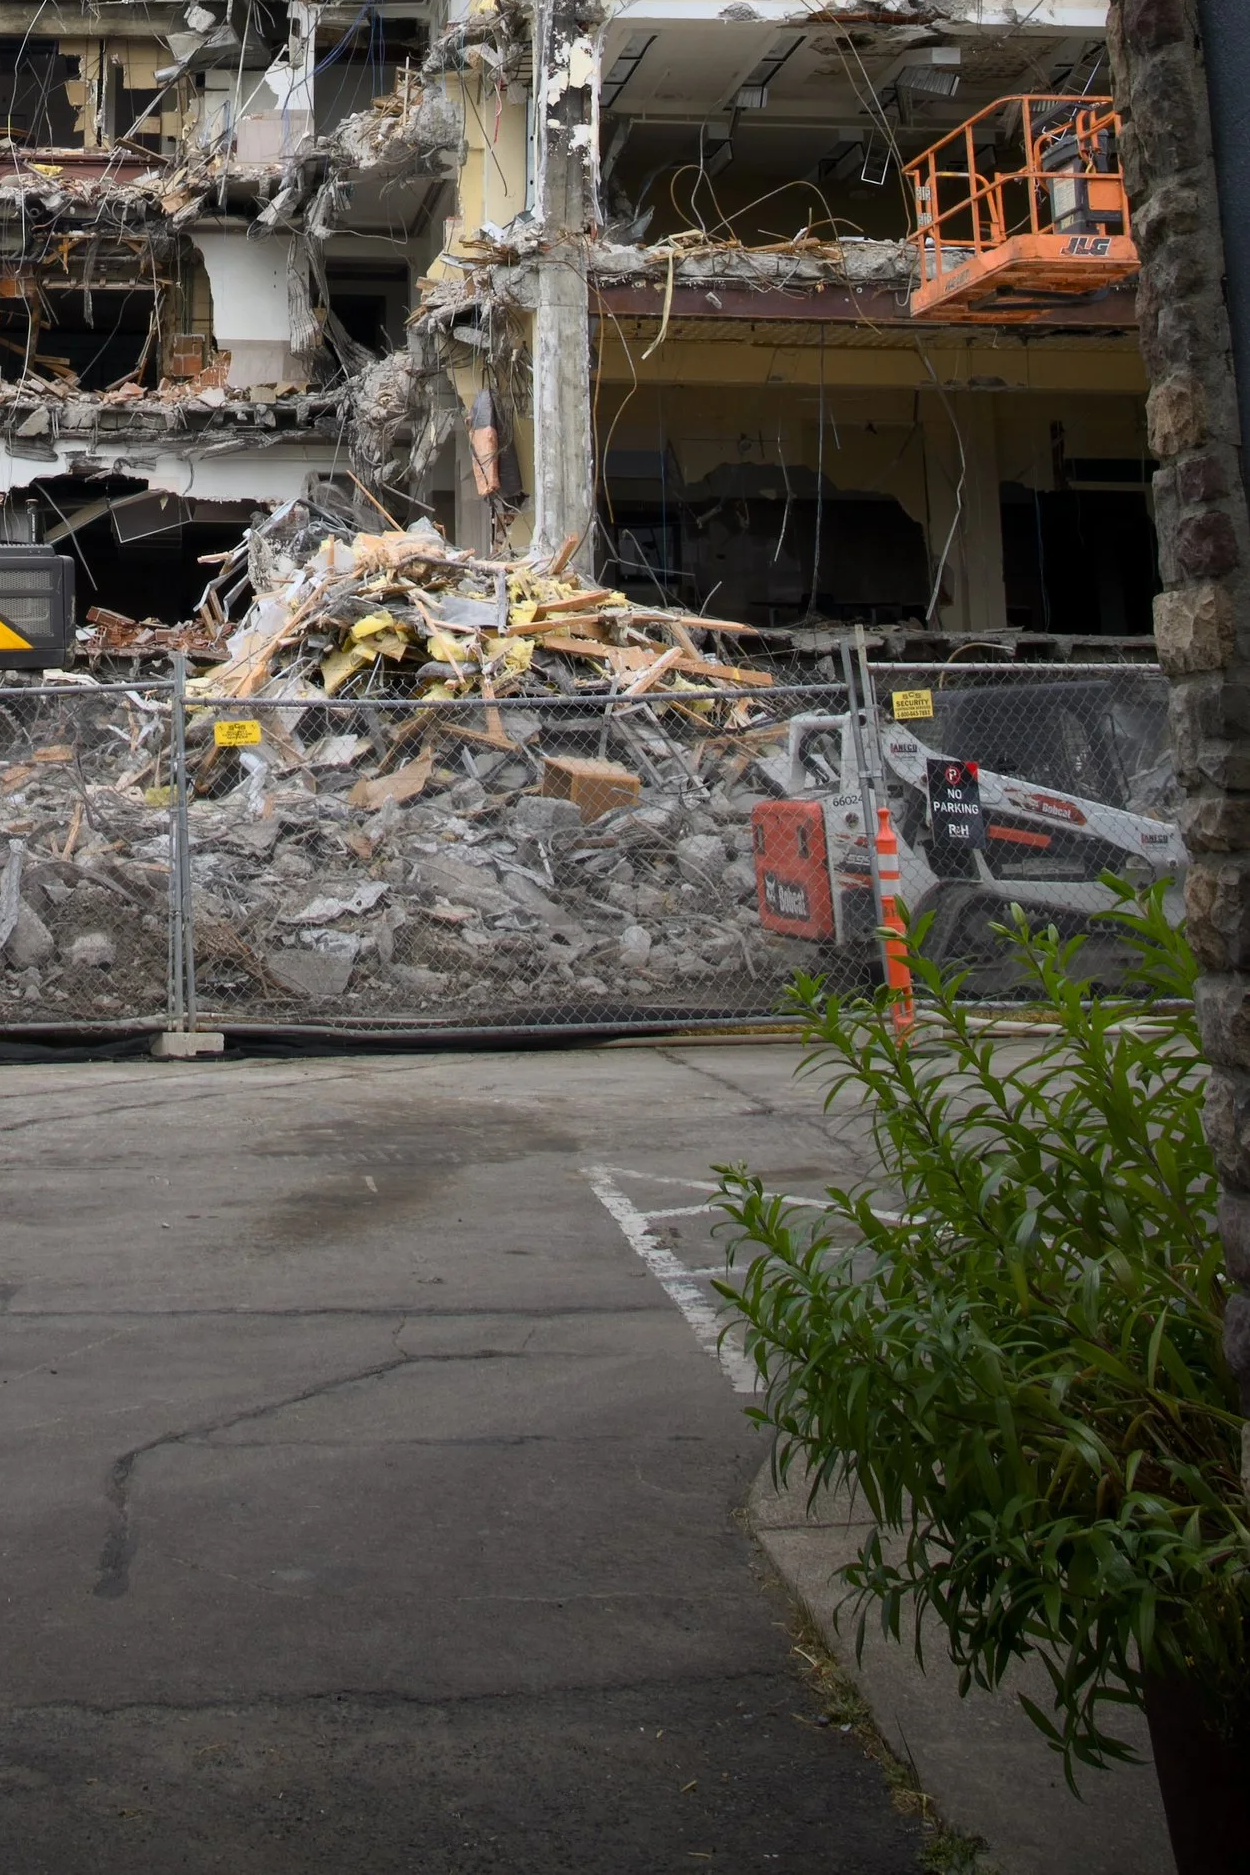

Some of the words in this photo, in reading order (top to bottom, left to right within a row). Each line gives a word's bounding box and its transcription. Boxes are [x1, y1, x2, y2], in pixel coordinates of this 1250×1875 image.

[1060, 237, 1111, 257] JLG
[895, 699, 929, 707] SECURITY
[947, 788, 962, 799] NO
[933, 801, 979, 814] PARKING
[1042, 801, 1071, 819] Bobcat
[778, 884, 807, 916] Bobcat
